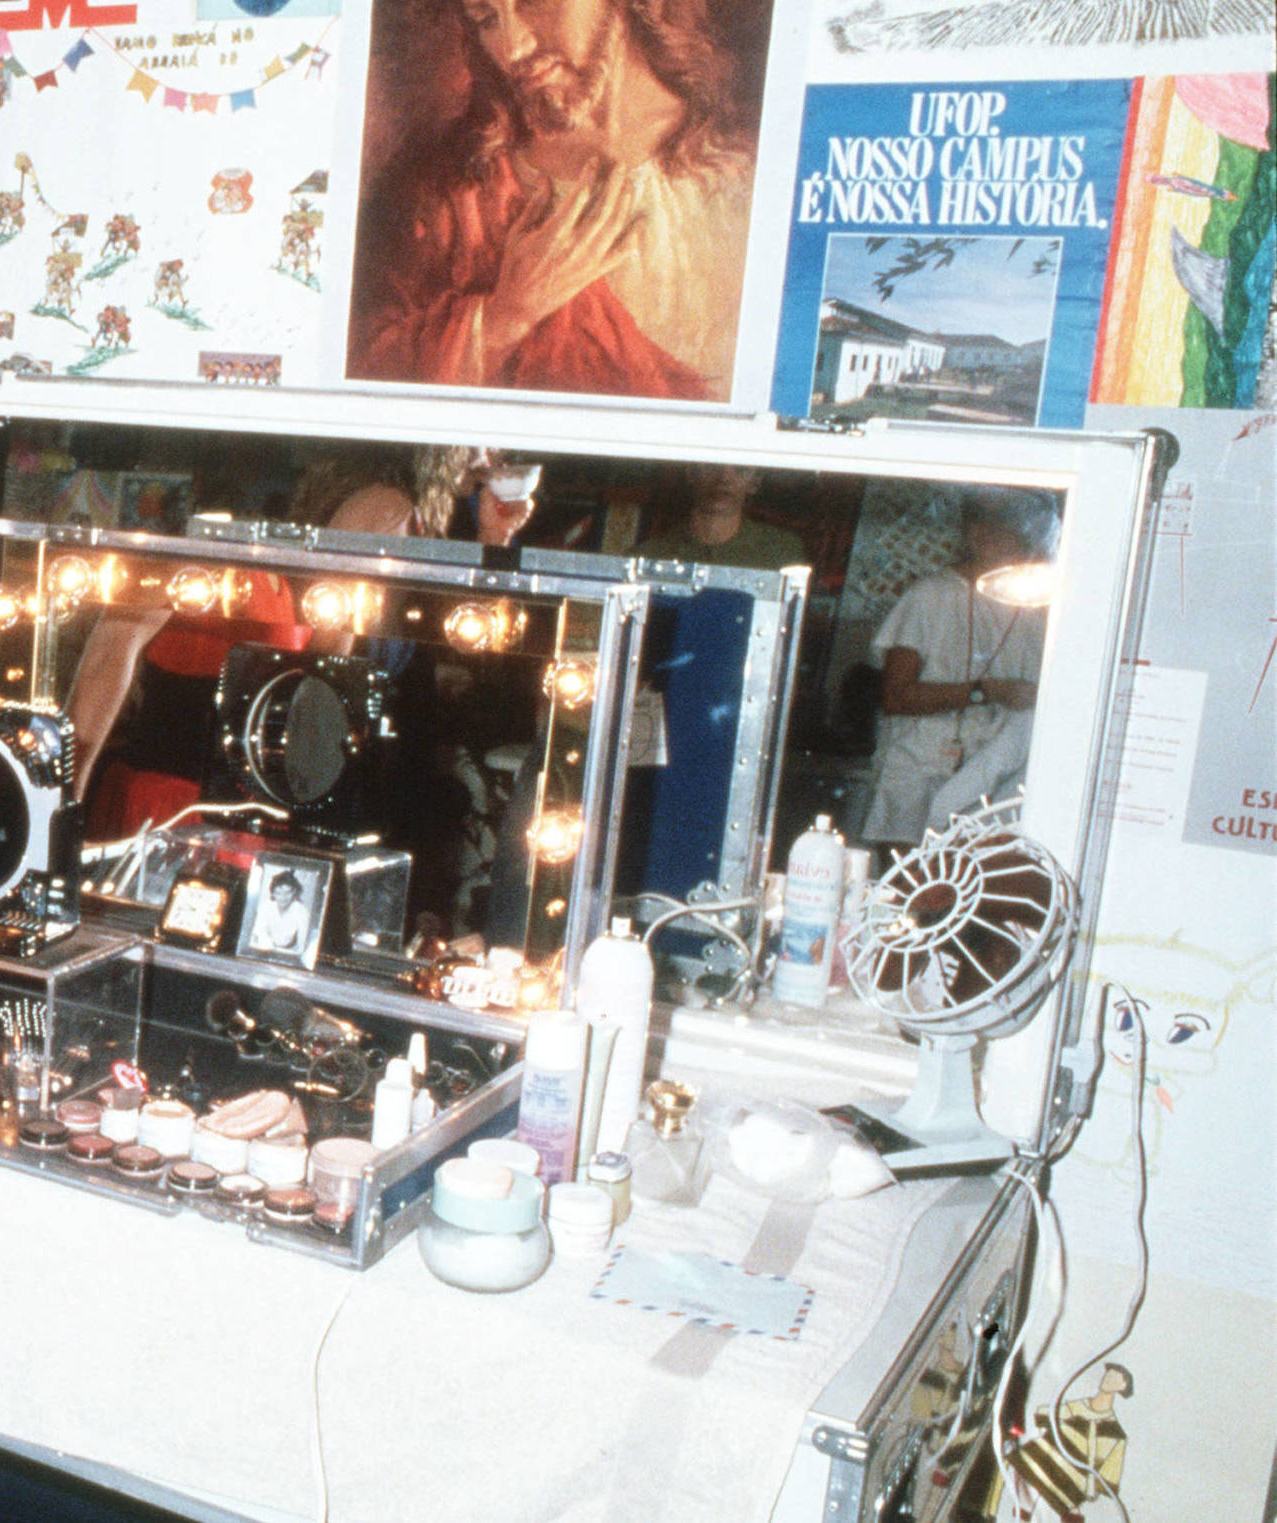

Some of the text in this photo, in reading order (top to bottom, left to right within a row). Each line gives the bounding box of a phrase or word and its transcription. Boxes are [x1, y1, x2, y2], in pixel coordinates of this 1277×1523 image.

[909, 91, 1007, 138] UFOP.
[825, 135, 1086, 182] NOSSO CAMPUS
[797, 172, 1109, 229] É NOSSA HISTÓRIA.
